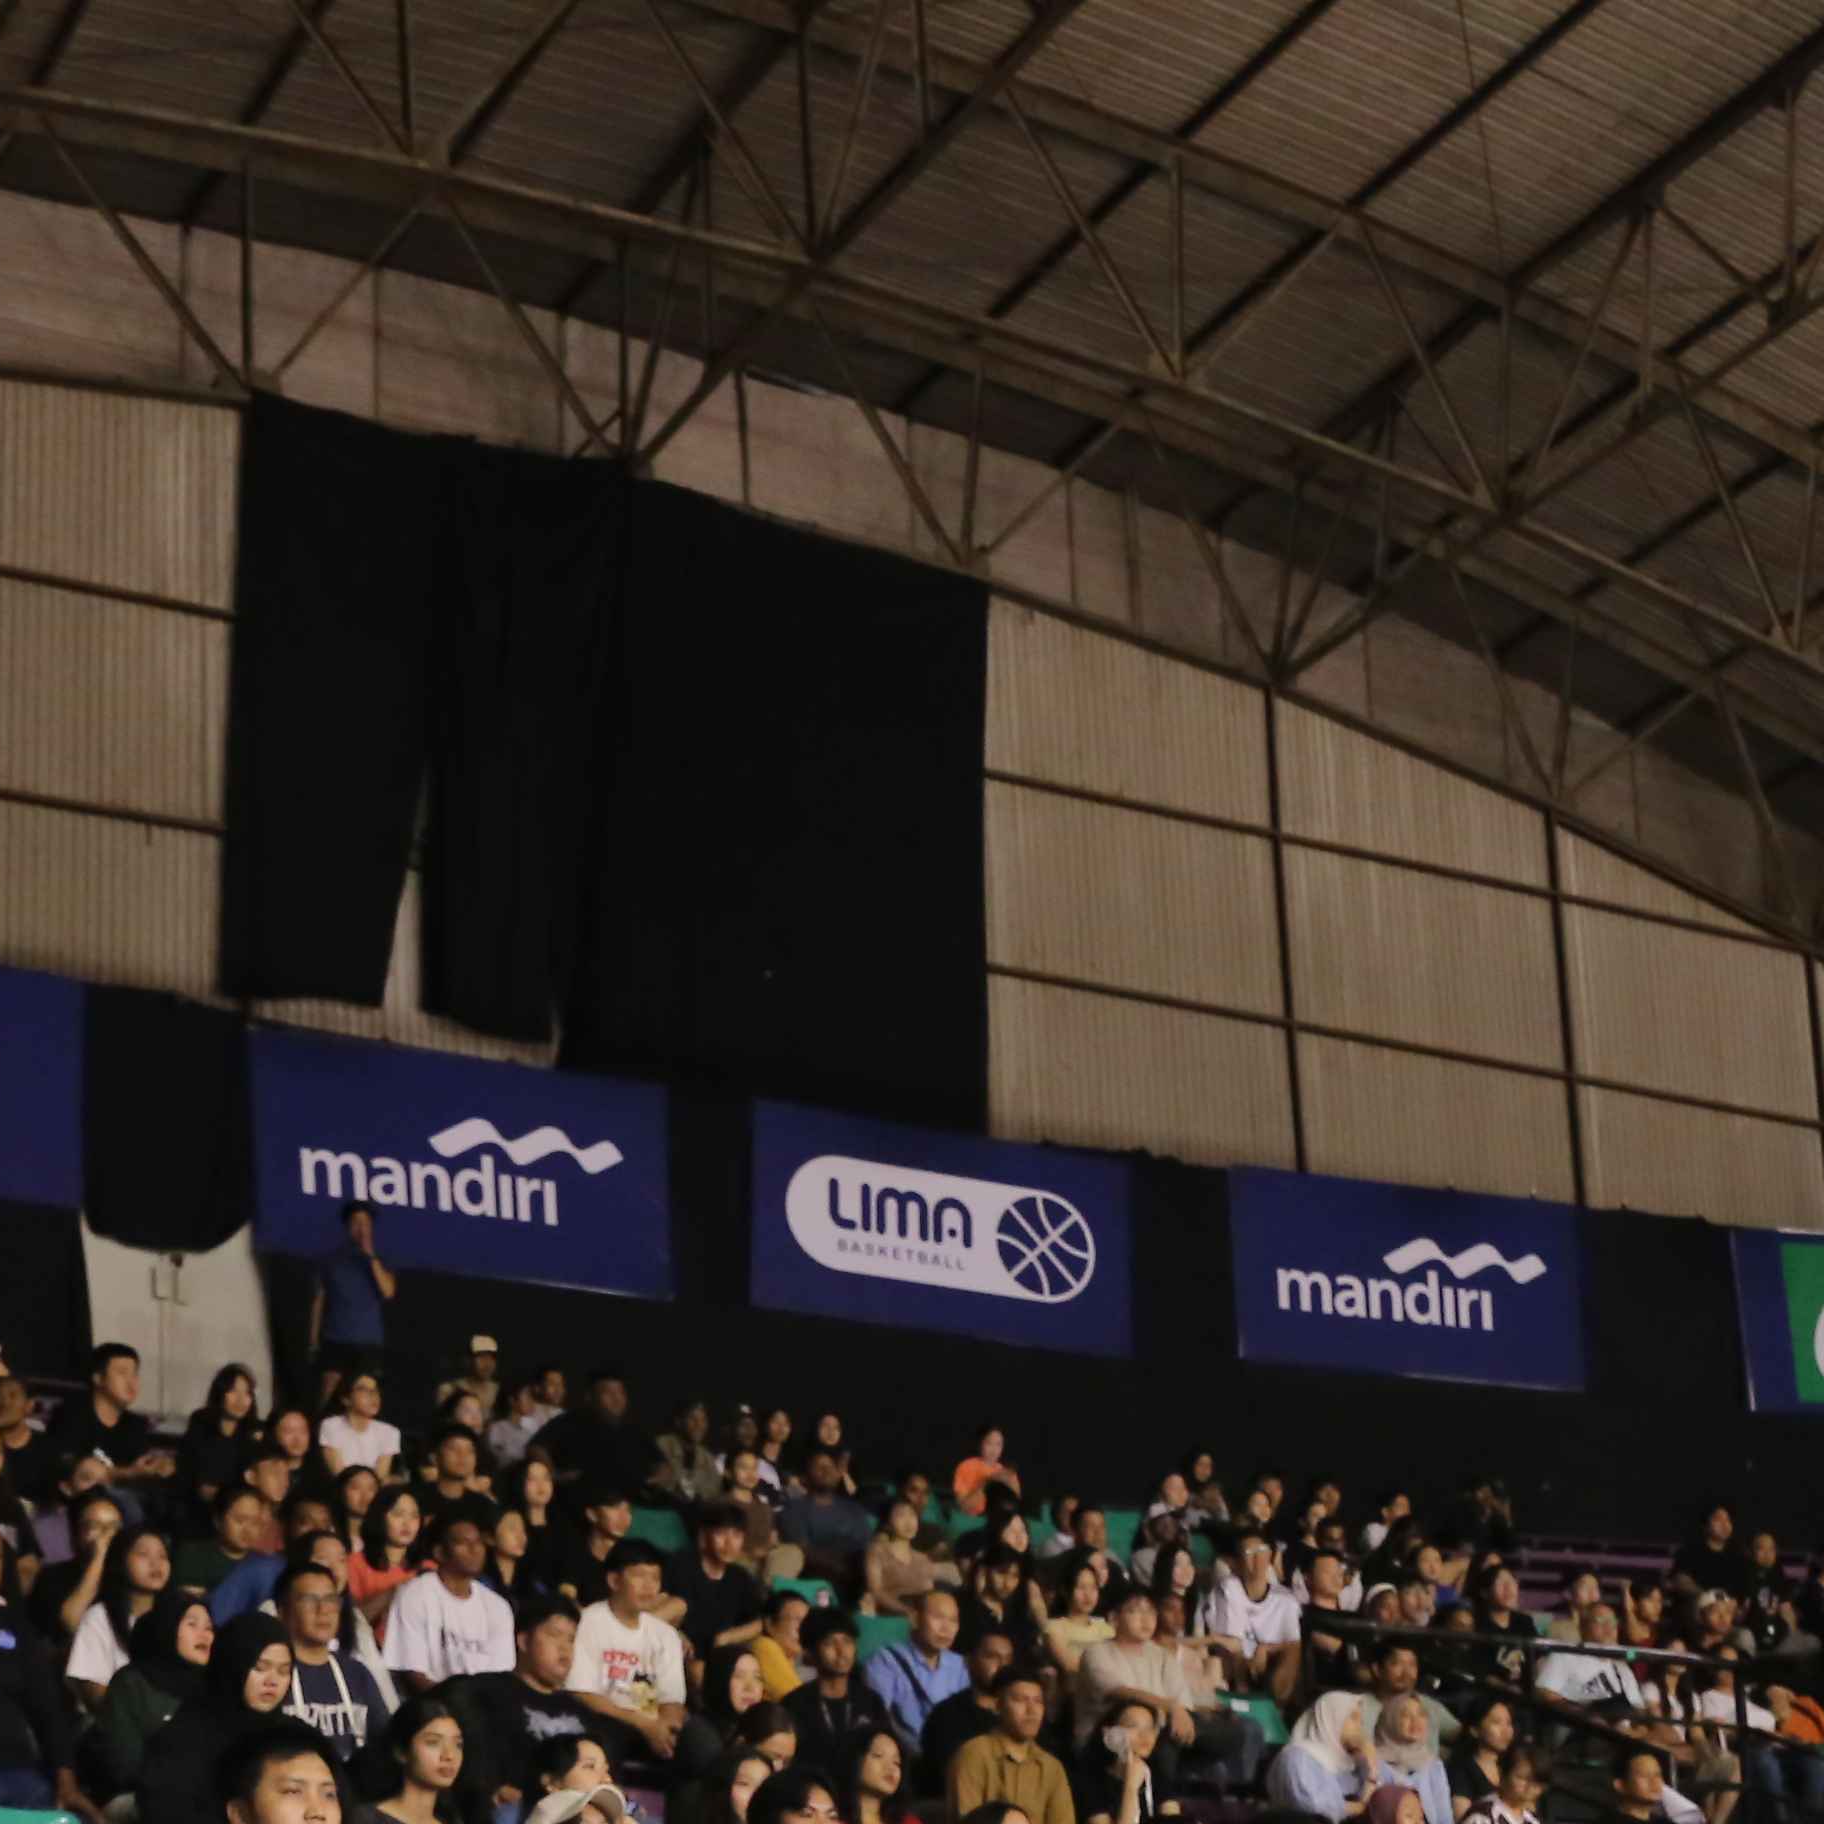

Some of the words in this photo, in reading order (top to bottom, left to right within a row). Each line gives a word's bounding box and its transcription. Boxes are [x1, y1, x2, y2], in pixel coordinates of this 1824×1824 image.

[298, 1146, 559, 1227] mandiri
[828, 1177, 973, 1249] LIMA
[837, 1237, 967, 1272] BASKETBALL
[1276, 1266, 1494, 1332] mandiri
